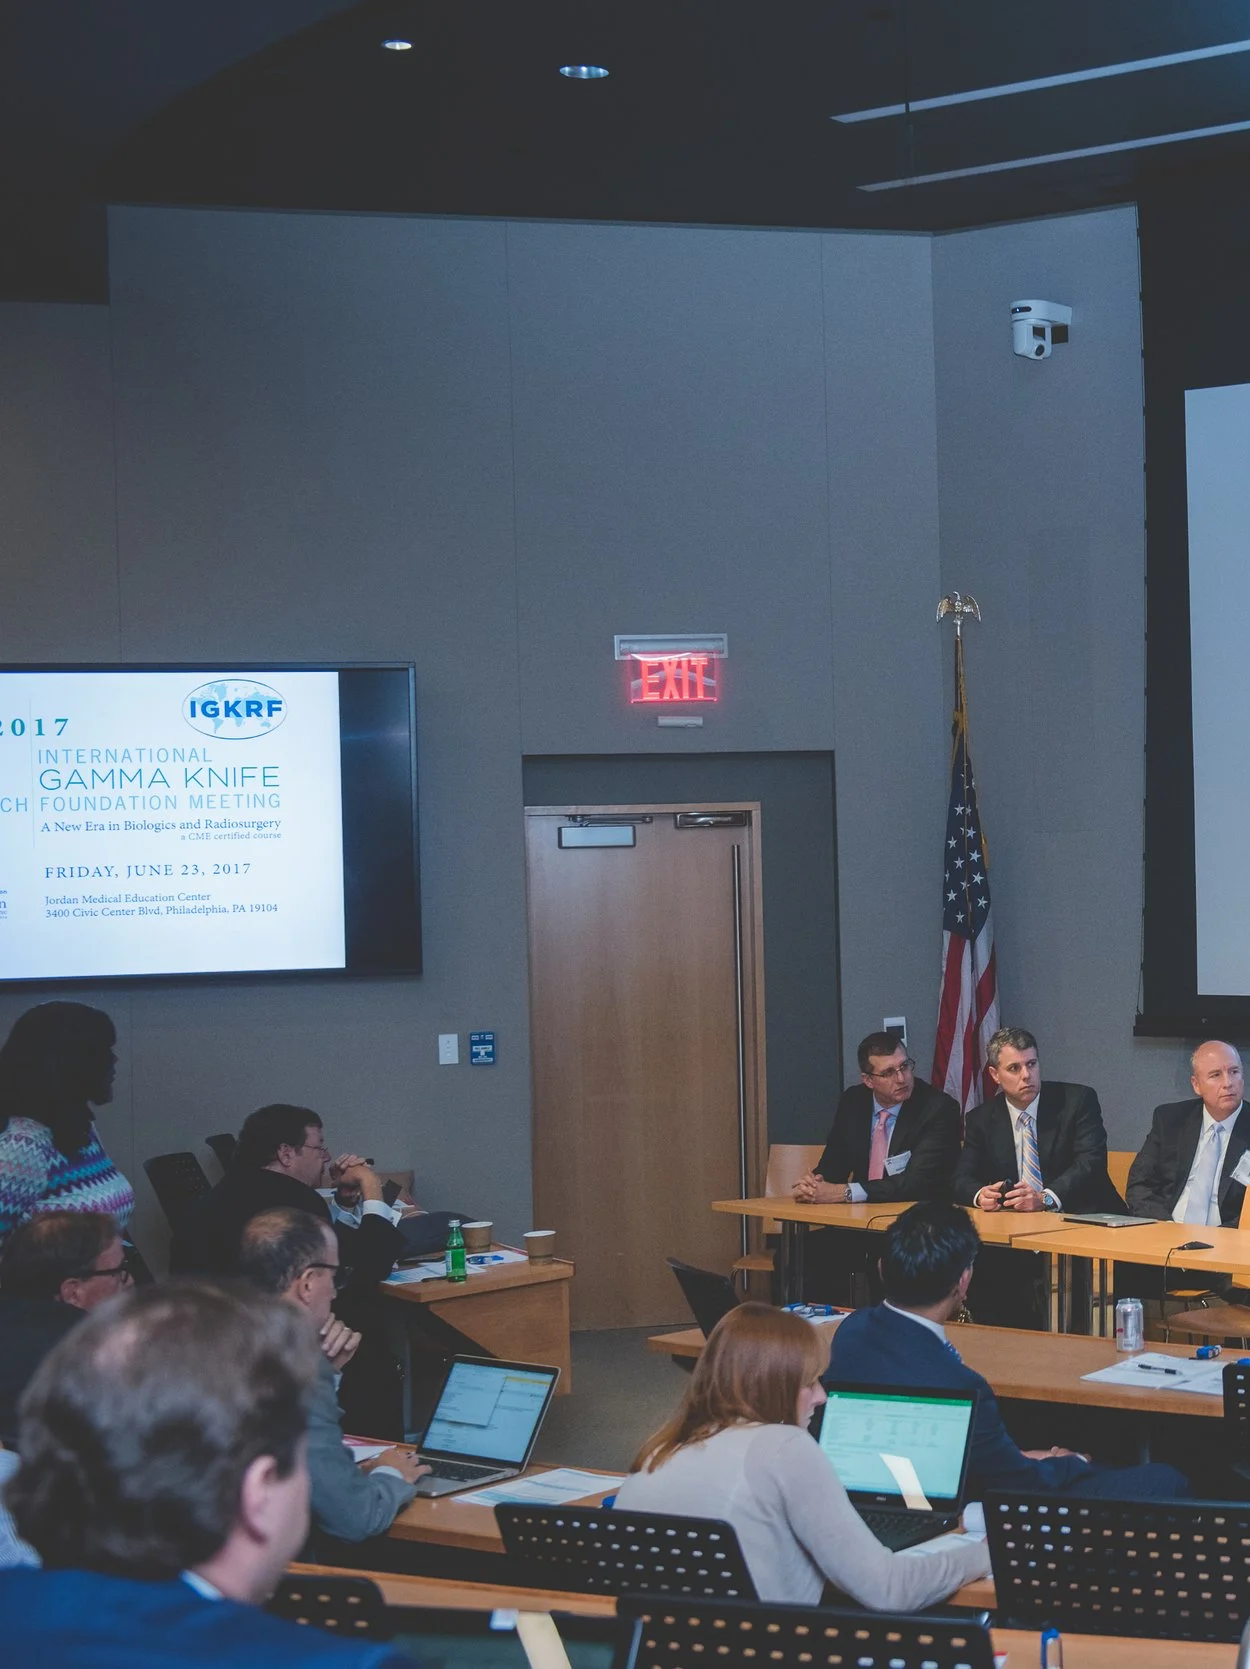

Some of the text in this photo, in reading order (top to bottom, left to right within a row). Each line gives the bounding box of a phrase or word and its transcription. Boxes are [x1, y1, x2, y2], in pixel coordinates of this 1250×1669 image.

[641, 657, 708, 700] EXIT
[189, 699, 283, 719] IGKRF
[37, 747, 213, 765] INTERNATIONAL
[39, 765, 280, 791] GAMMA KNIFE
[39, 794, 177, 813] FOUNDATION
[188, 792, 281, 810] MEETING
[40, 818, 282, 834] A New Era in Biologics and Radiosurgery
[188, 832, 212, 841] CME
[213, 831, 251, 841] certified
[252, 832, 282, 840] course
[45, 862, 251, 879] FRIDAY, JUNE 23, 2017
[45, 892, 212, 907] Jordan Medical Education Center
[45, 903, 278, 919] 3400 Civic Center Blvd, Philadelphia, PA 19104
